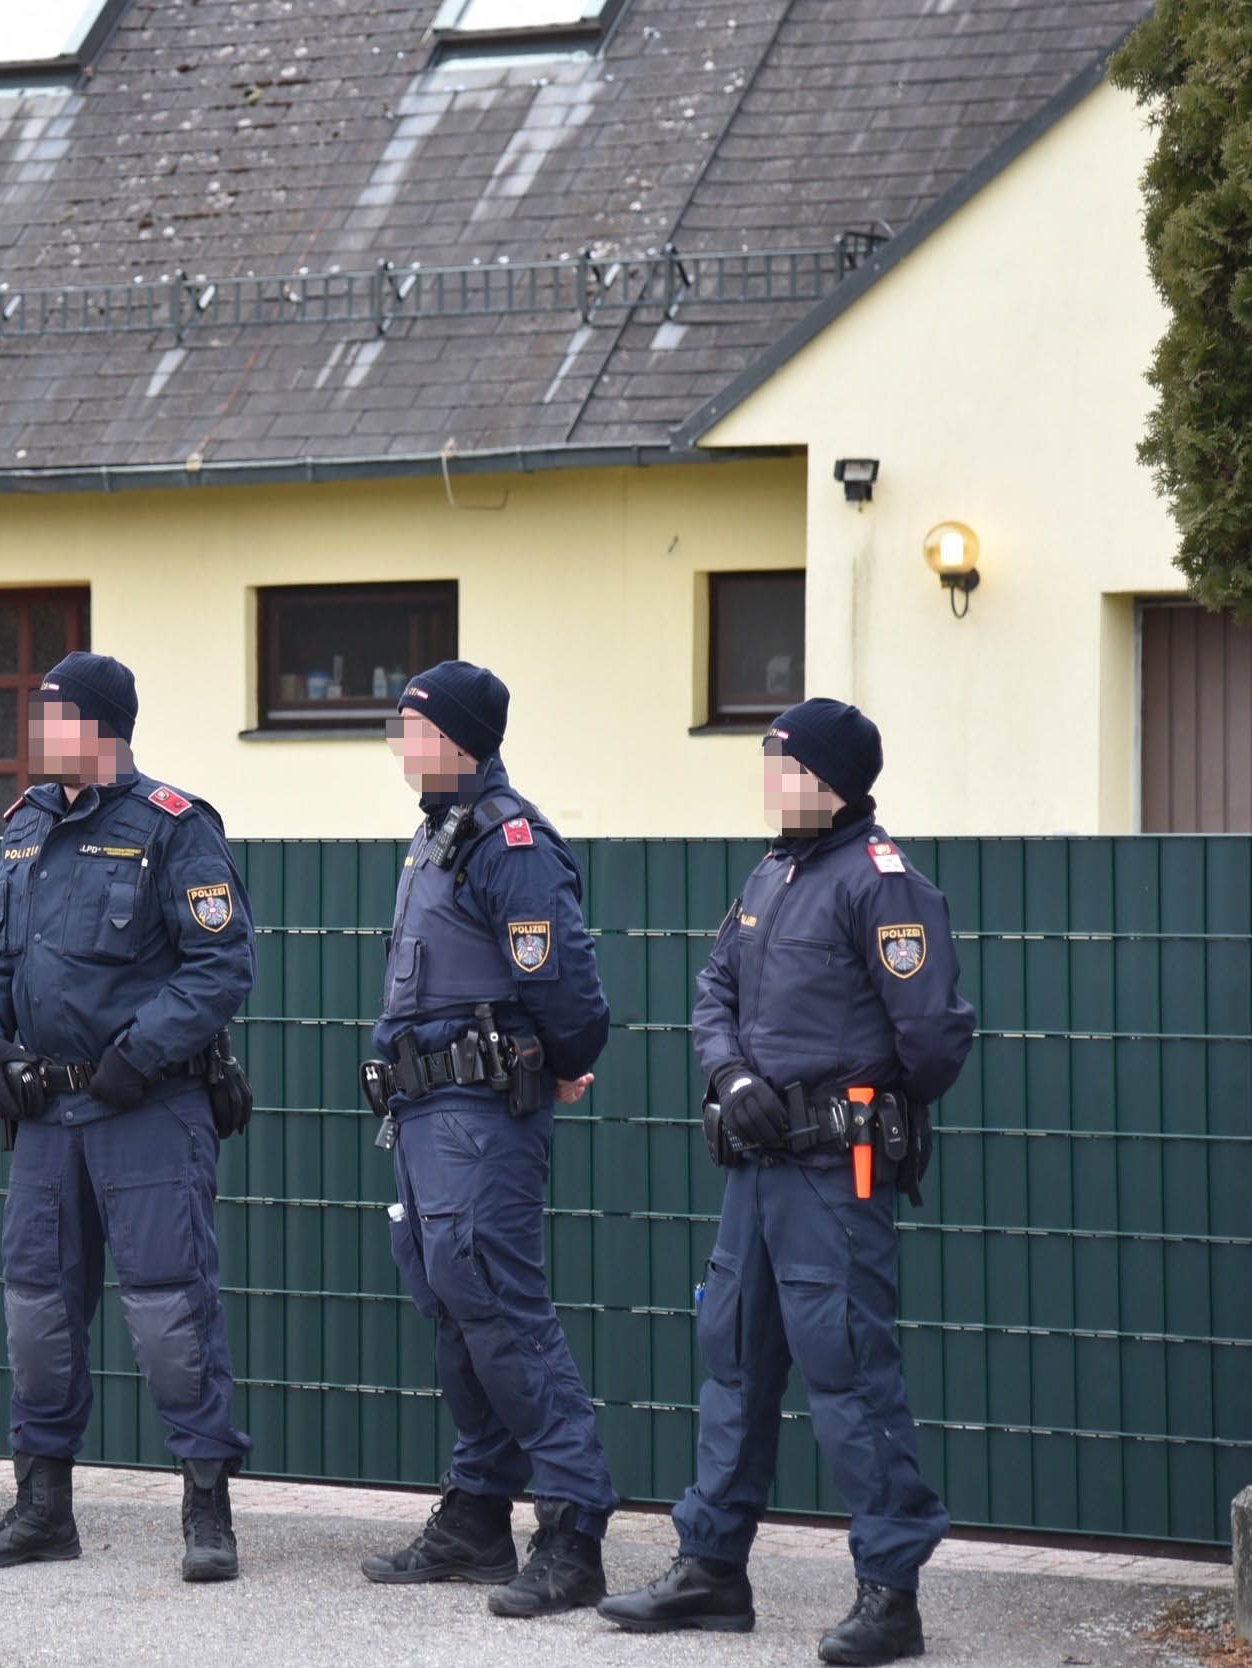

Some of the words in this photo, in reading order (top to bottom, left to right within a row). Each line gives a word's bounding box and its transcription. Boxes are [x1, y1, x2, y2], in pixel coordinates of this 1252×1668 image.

[191, 885, 226, 900] POLIZEI
[511, 925, 547, 935] POLIZEI
[881, 928, 921, 940] POLIZEI
